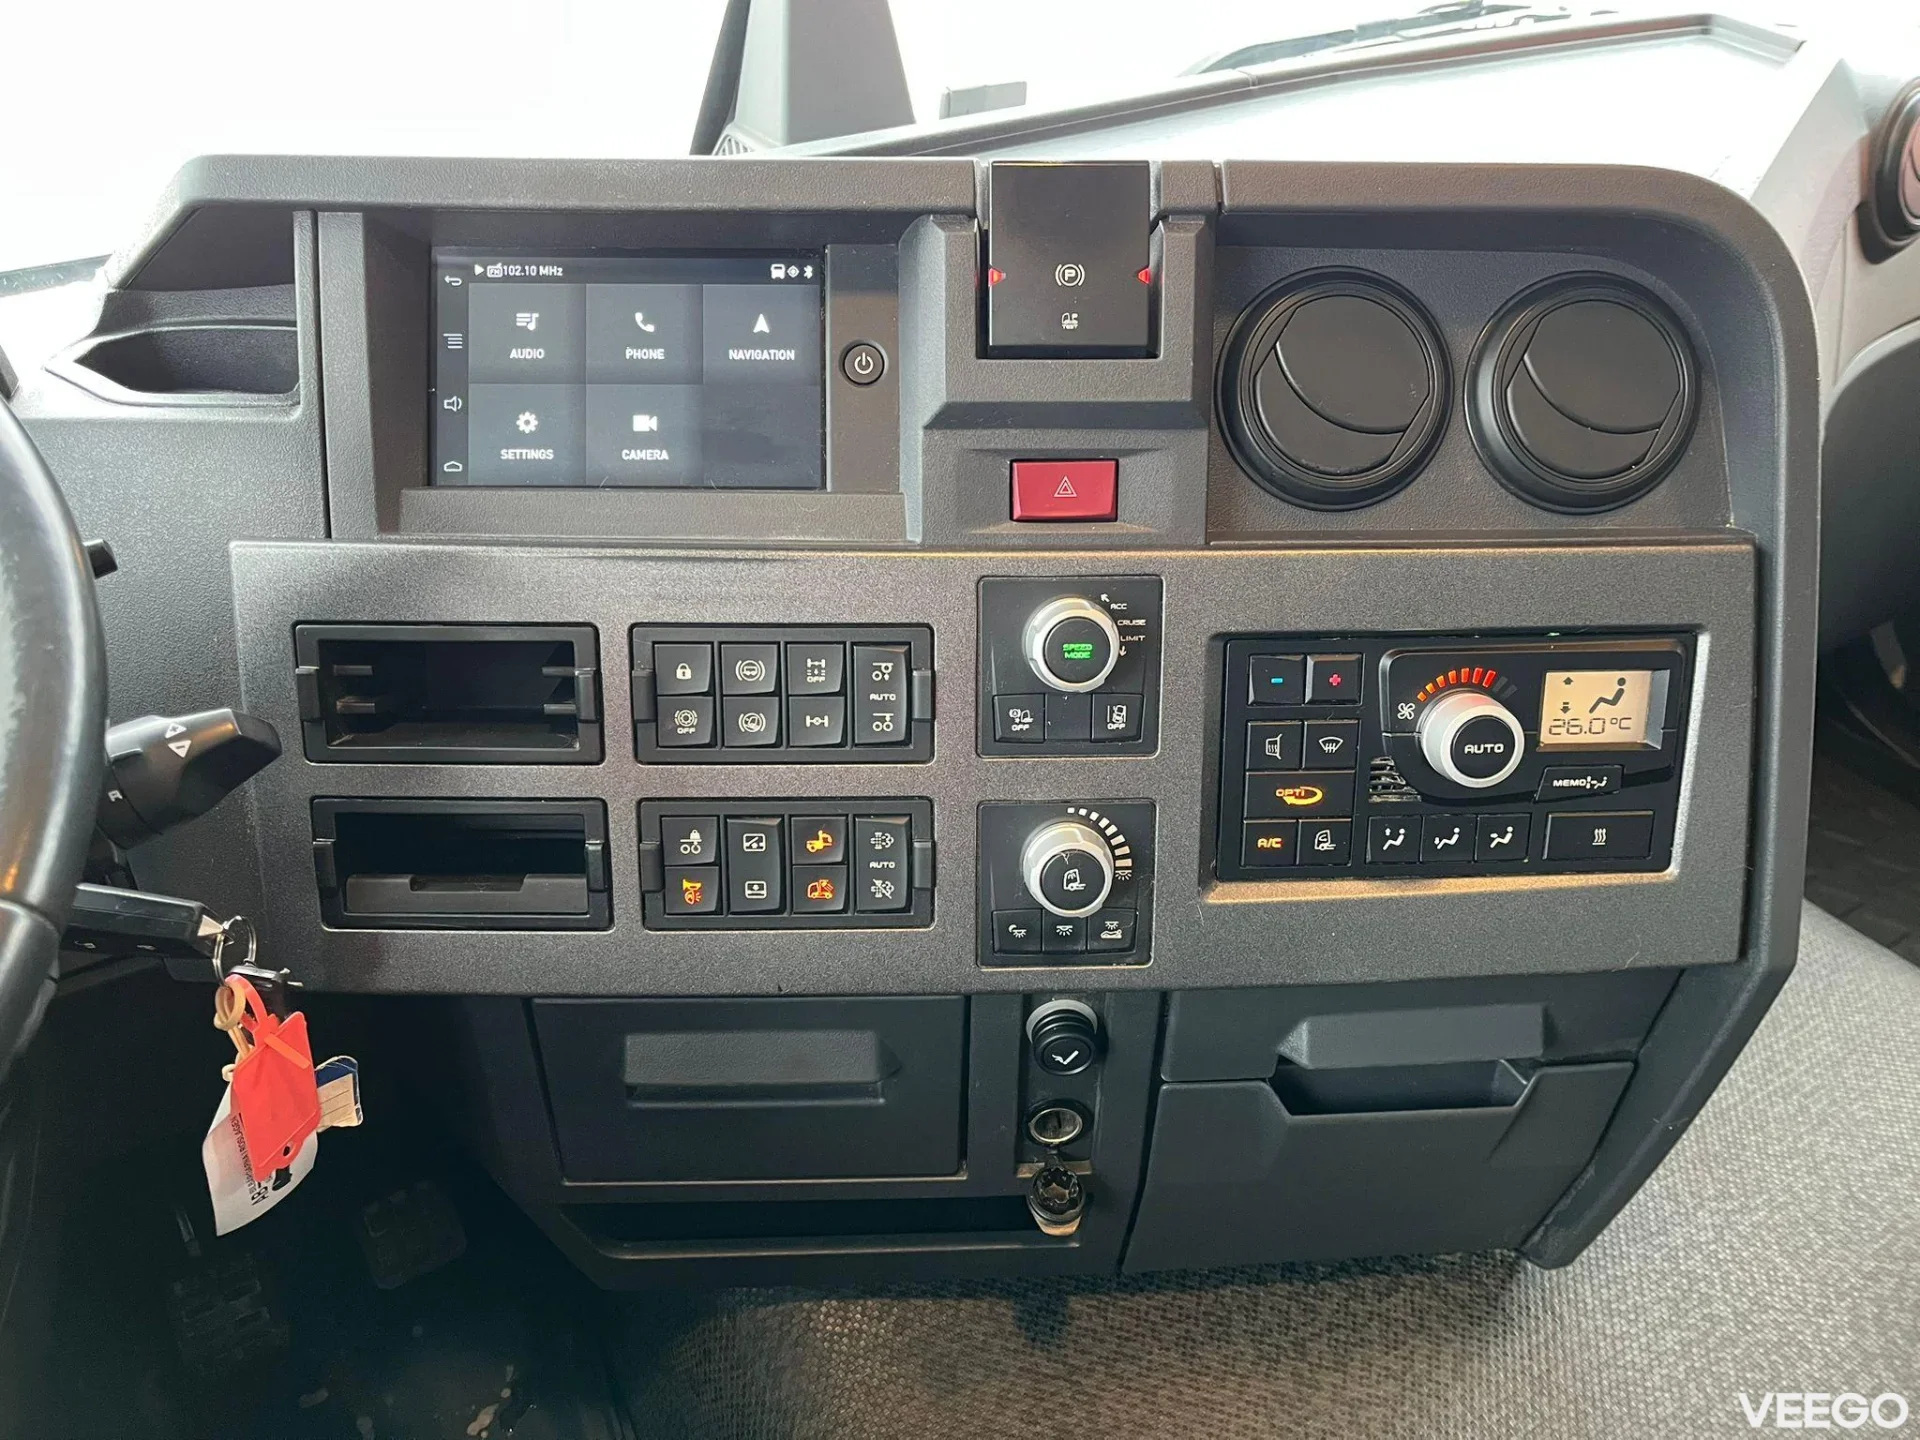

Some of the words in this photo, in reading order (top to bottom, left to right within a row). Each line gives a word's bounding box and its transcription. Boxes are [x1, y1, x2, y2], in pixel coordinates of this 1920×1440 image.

[502, 265, 537, 276] 102.10
[539, 265, 563, 276] MHz
[509, 347, 545, 360] AUDIO
[625, 347, 665, 360] PHONE
[728, 348, 796, 361] NAVIGATION
[500, 448, 554, 461] SETTINGS
[621, 448, 669, 461] CAMERA
[1110, 602, 1128, 610] ACC
[1120, 634, 1146, 642] LIMIT
[1062, 643, 1093, 651] SPEED
[1064, 651, 1091, 659] MODE
[807, 675, 826, 683] OFF
[869, 693, 896, 701] AUTO
[676, 727, 696, 735] OFF
[1011, 724, 1030, 732] OFF
[1464, 743, 1504, 755] AUTO
[1552, 779, 1586, 787] MEMO
[1275, 788, 1305, 797] OPTI
[1257, 838, 1282, 848] A/C
[869, 861, 896, 869] AUTO
[230, 1116, 247, 1152] ROSLAGEN
